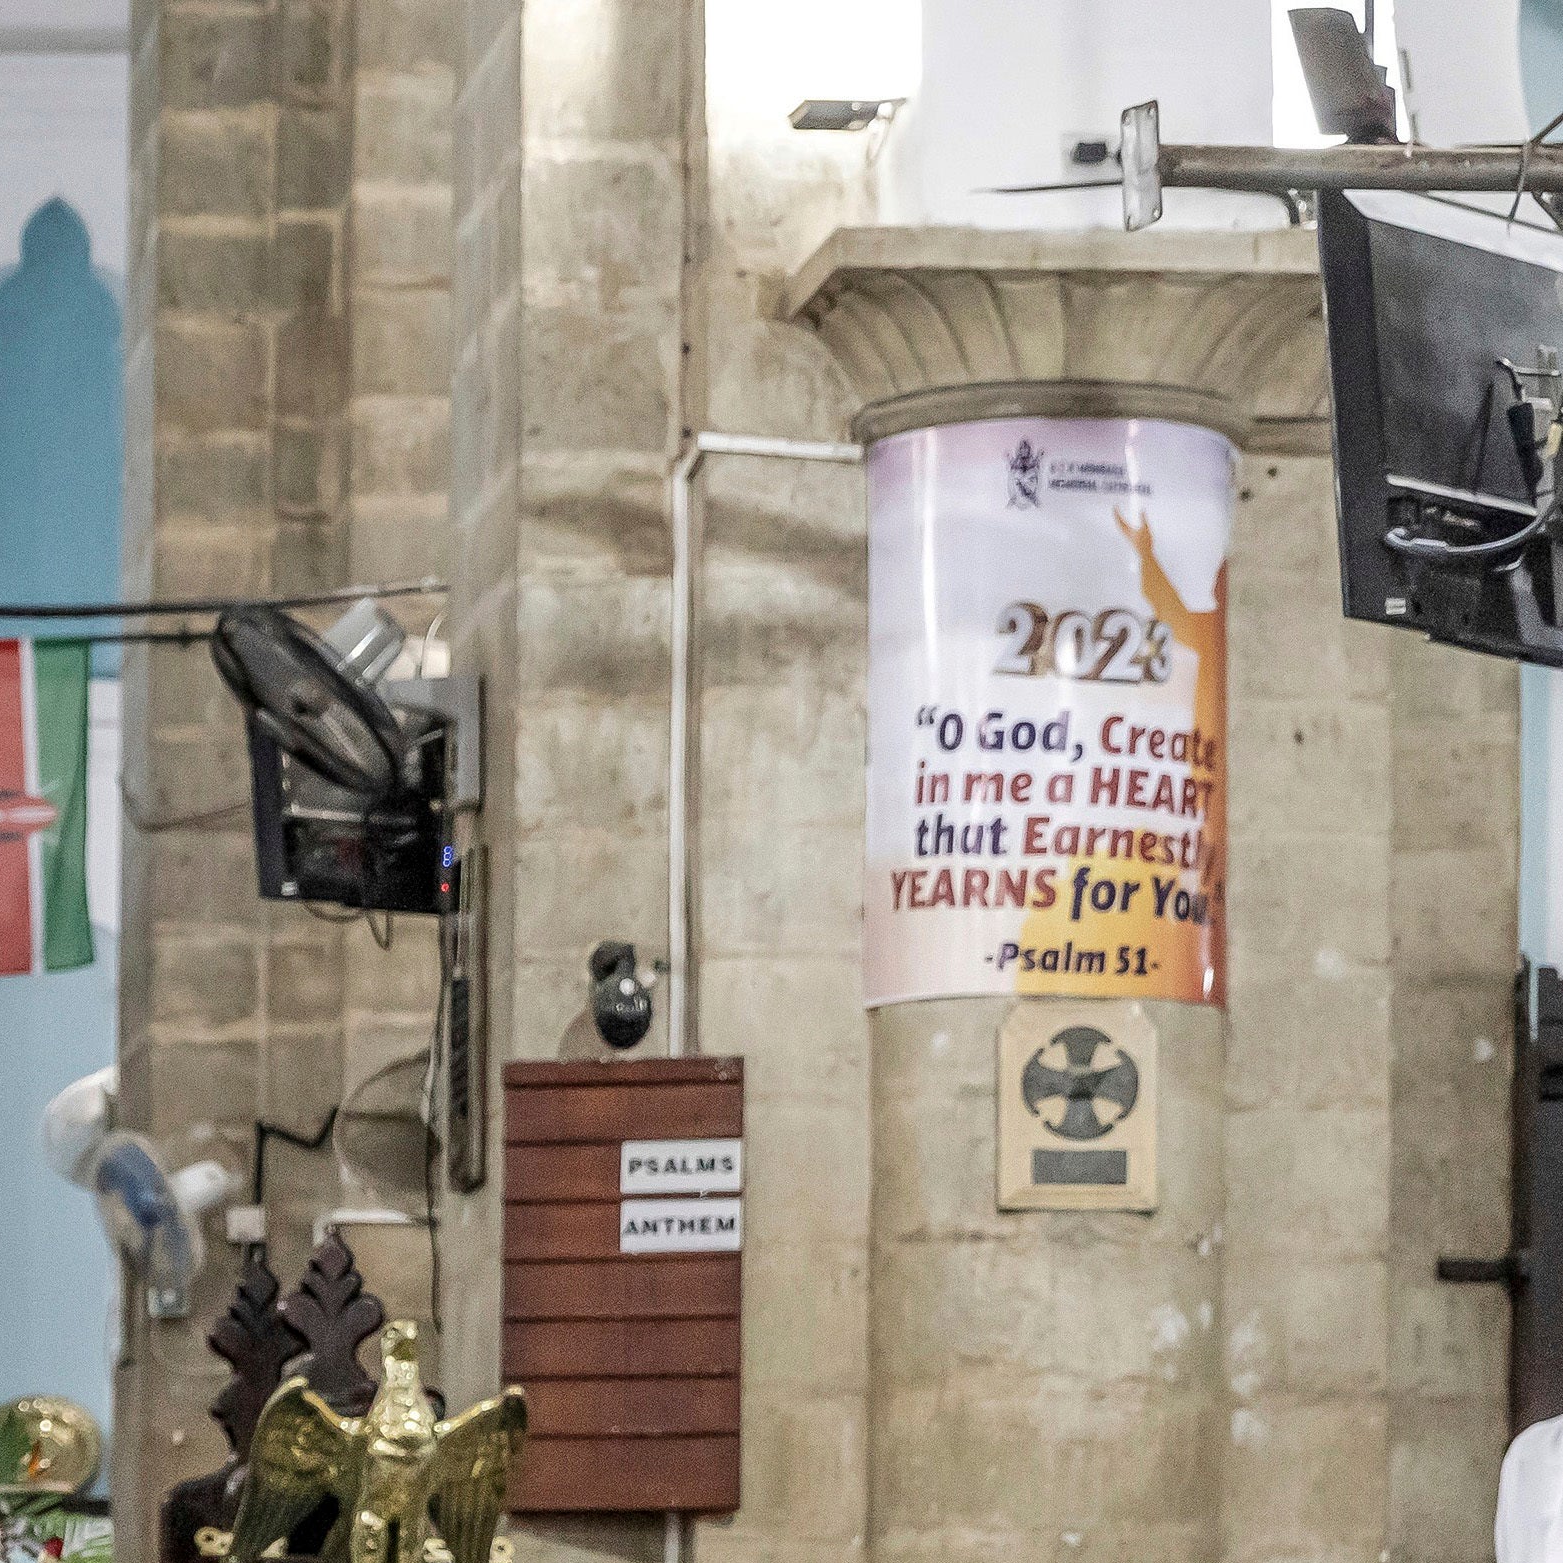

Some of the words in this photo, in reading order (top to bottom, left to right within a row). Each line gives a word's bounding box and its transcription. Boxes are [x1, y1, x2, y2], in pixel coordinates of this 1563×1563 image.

[992, 602, 1173, 684] 2023
[979, 710, 1084, 762] God,
[1101, 716, 1215, 772] Create
[917, 760, 949, 804] in
[964, 772, 1032, 803] me
[1048, 773, 1074, 803] a
[1090, 767, 1214, 820] HEART
[917, 813, 1007, 856] that
[891, 868, 1056, 911] YEARNS
[1072, 866, 1140, 920] for
[628, 1156, 733, 1175] PSALMS
[623, 1216, 735, 1235] ANTHEM
